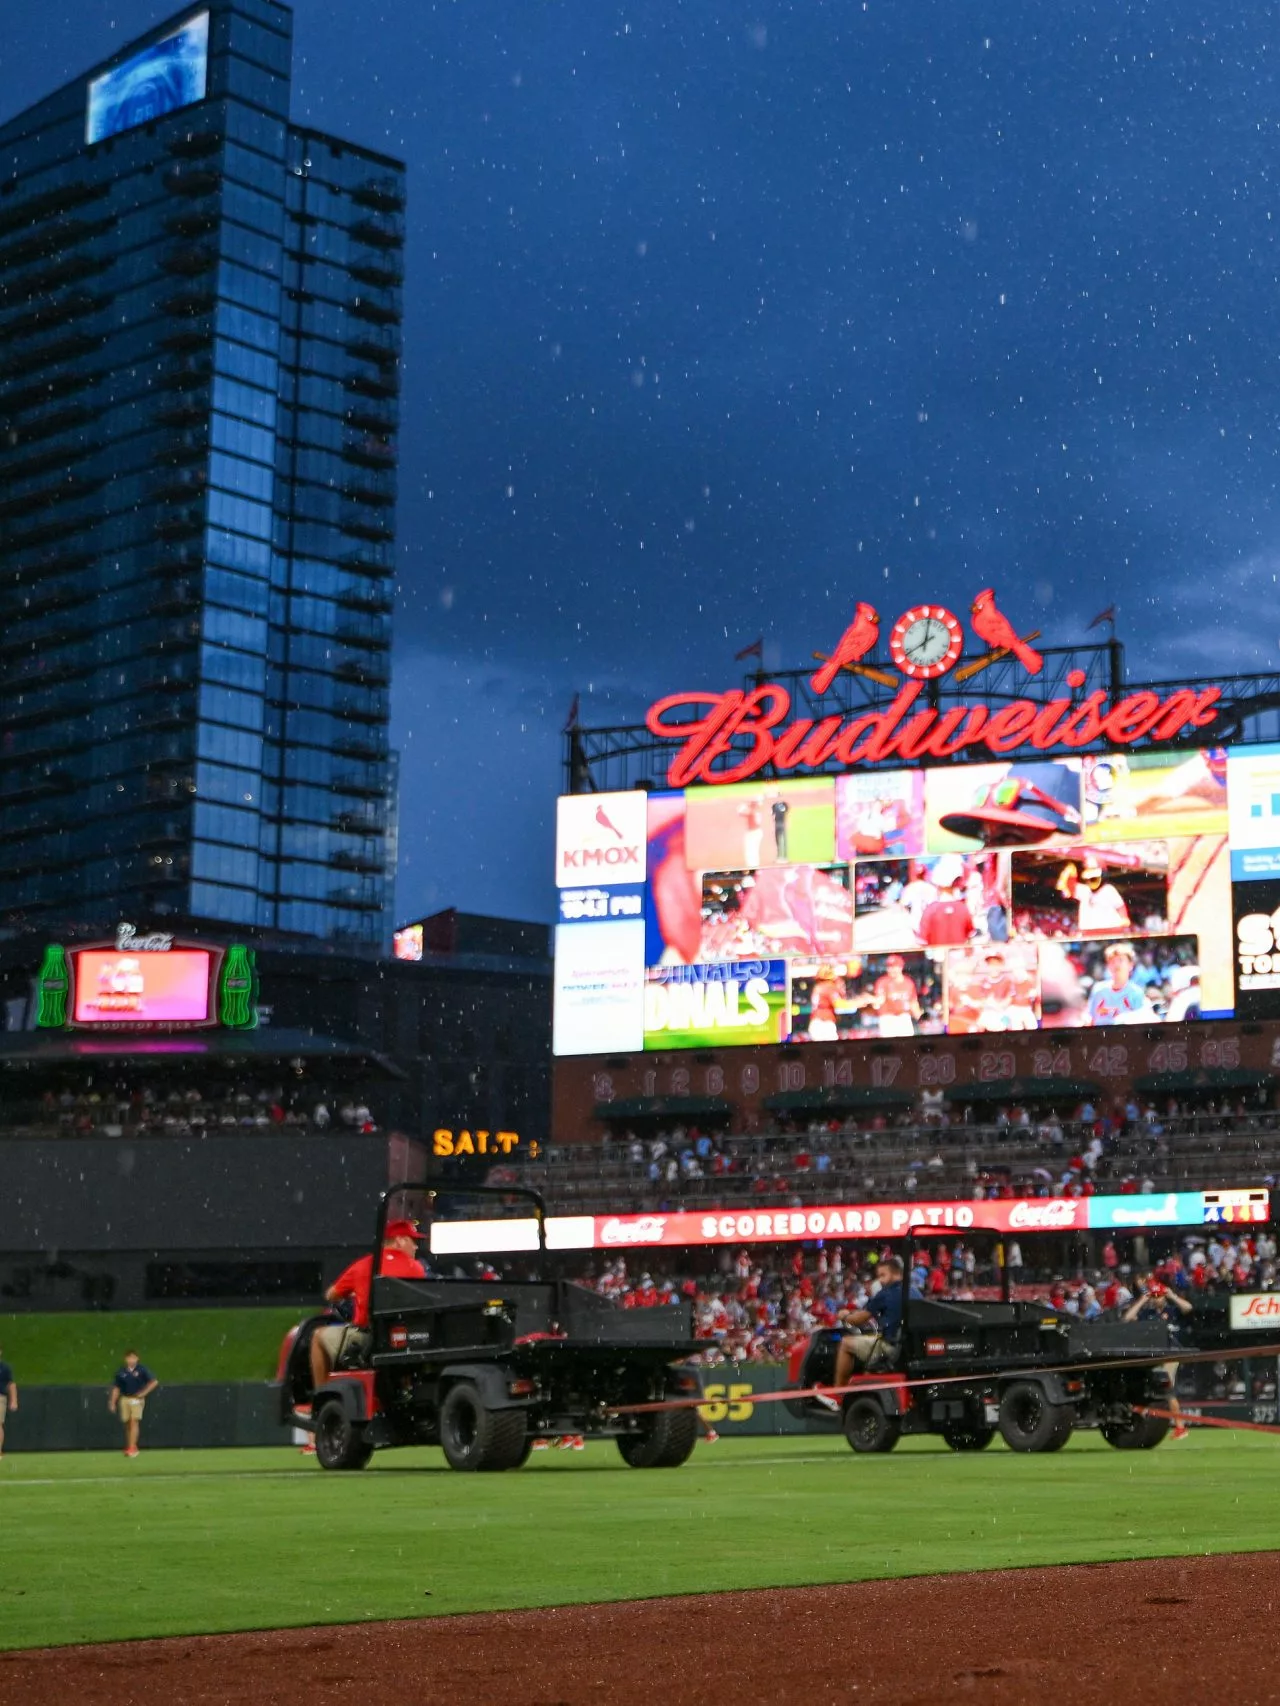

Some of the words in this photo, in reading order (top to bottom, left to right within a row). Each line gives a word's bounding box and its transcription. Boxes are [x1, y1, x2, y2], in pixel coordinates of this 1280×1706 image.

[646, 669, 1222, 787] Budweiser
[563, 845, 640, 868] KMOX
[778, 1062, 805, 1092] 10
[823, 1058, 852, 1088] 14
[870, 1057, 902, 1088] 17
[918, 1054, 957, 1086] 20
[979, 1053, 1016, 1082] 23
[1033, 1048, 1071, 1078] 24
[1091, 1046, 1129, 1077] 42
[1148, 1042, 1188, 1073] 45
[701, 1210, 881, 1237] SCOREBOARD
[892, 1206, 973, 1231] PATIO
[1009, 1200, 1079, 1228] Coca-Cola
[699, 1384, 754, 1422] 65
